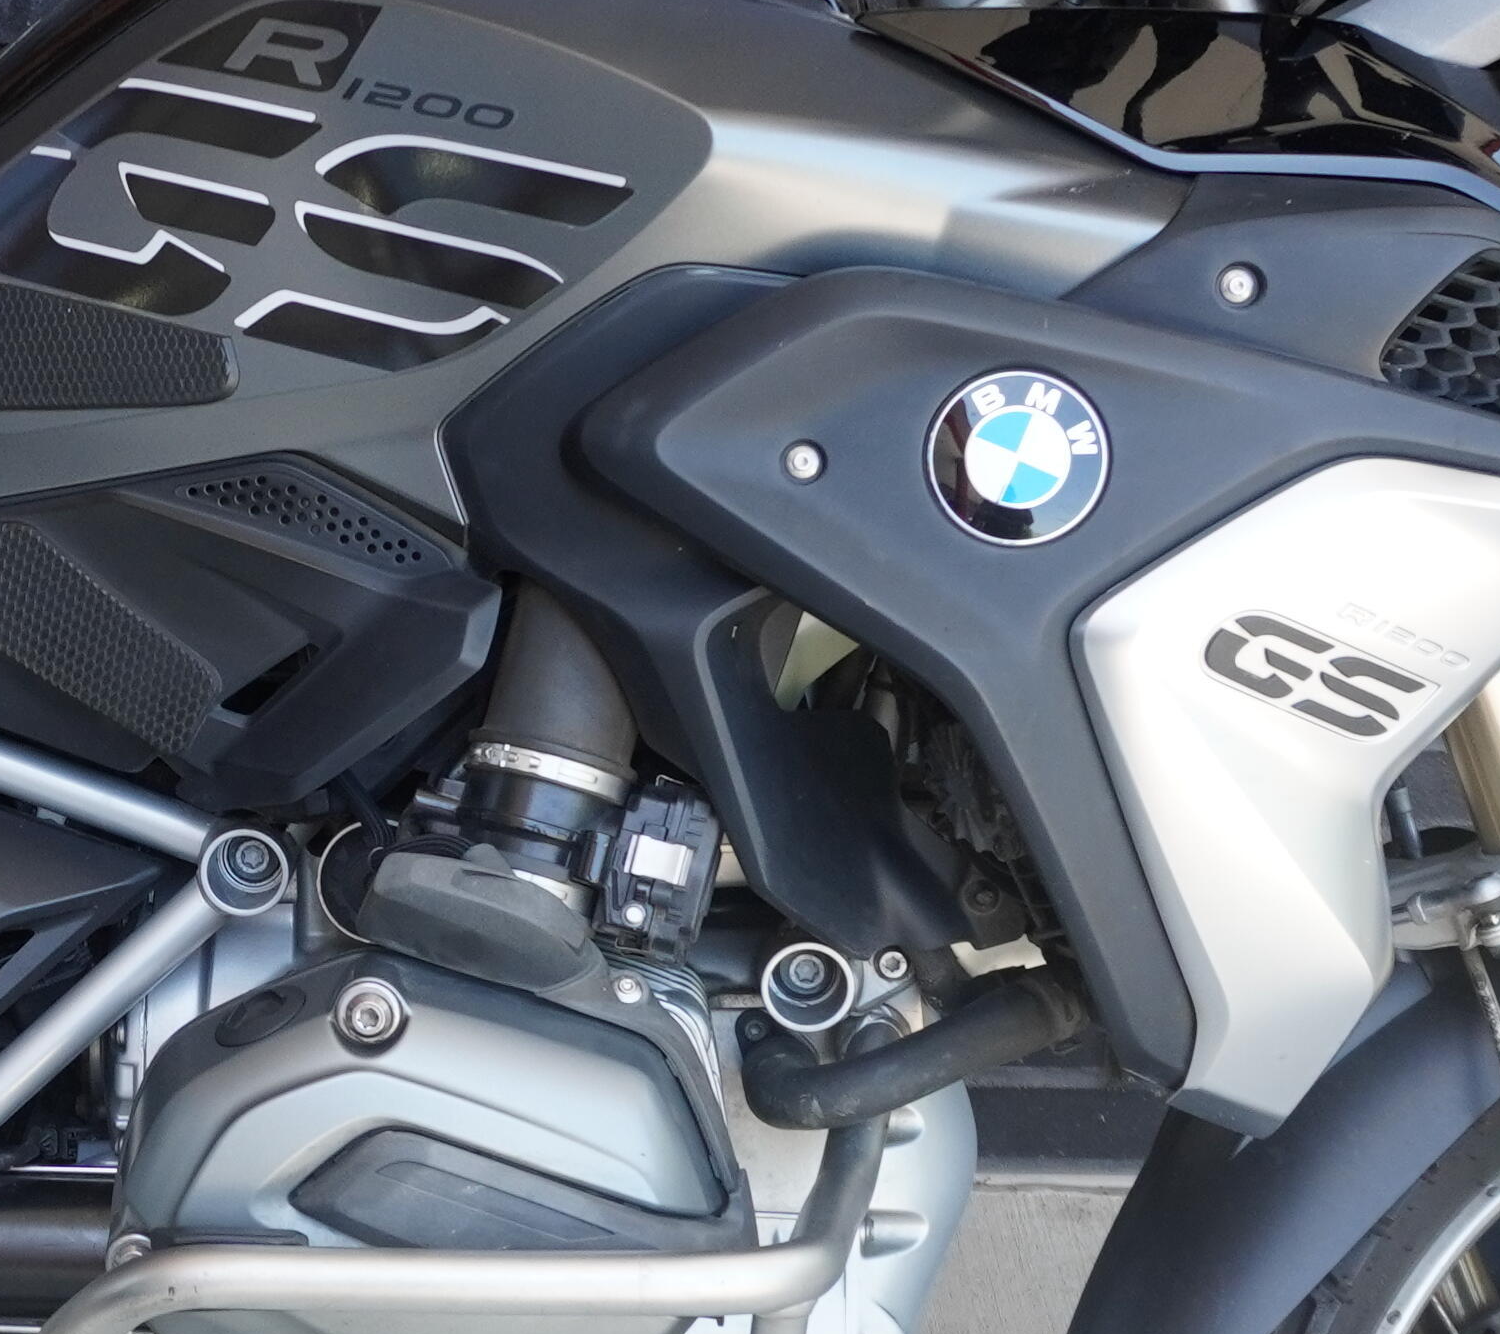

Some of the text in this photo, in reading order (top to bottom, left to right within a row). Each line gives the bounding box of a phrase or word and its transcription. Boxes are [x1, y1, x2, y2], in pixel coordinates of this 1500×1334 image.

[225, 17, 515, 131] R 1200
[970, 381, 1099, 455] BMW
[1203, 613, 1426, 738] GS
